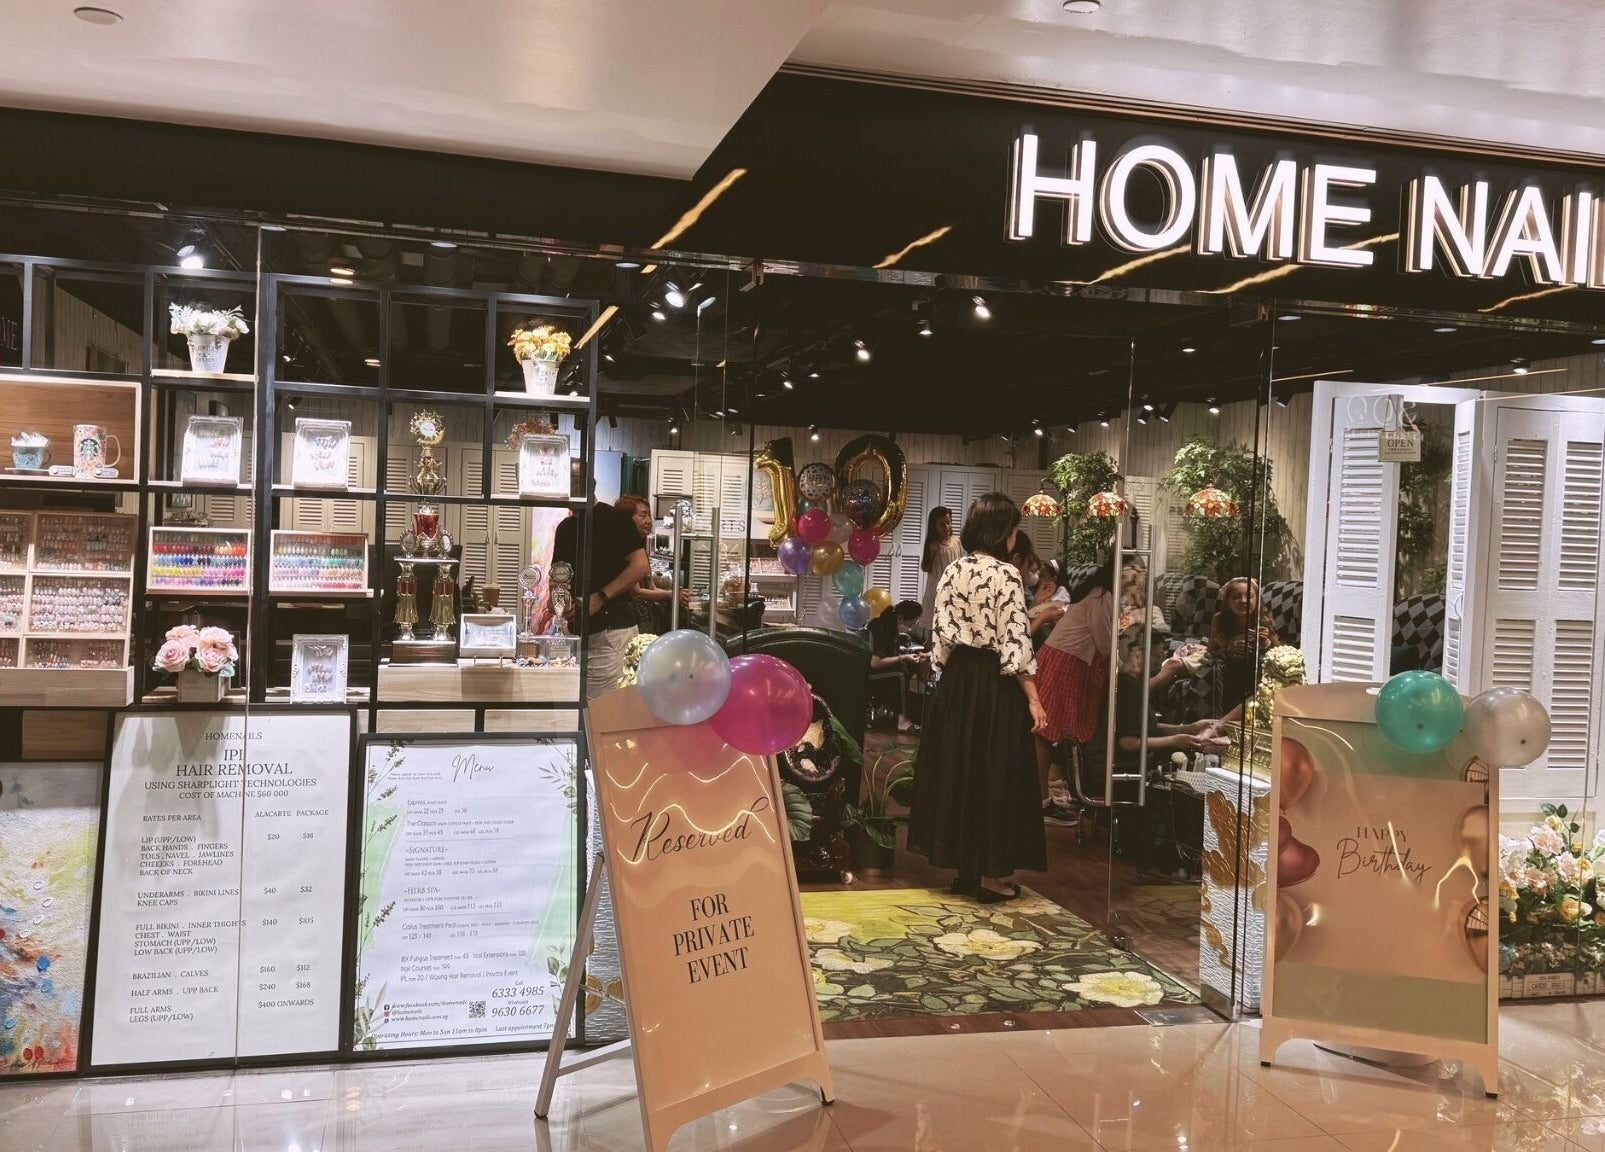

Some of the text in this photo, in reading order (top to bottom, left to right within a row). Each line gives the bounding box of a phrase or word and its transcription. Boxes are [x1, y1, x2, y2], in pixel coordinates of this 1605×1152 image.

[1008, 134, 1605, 288] HOME NAI
[1387, 439, 1414, 448] OPEN
[205, 732, 262, 740] HOMENILS
[176, 762, 292, 776] HAIR REMOVAL
[452, 754, 494, 783] Menu
[144, 778, 317, 790] USING SHARPLIGHT ECHNOLOGIES
[631, 797, 769, 861] Reserved
[154, 836, 196, 844] (UPP/LOW)
[1337, 838, 1432, 886] Birthday
[137, 891, 184, 899] UNDERARMS
[263, 887, 276, 895] $40
[690, 893, 728, 921] FOR
[673, 916, 755, 956] PRIVATE
[173, 937, 216, 946] (UPP/LOW)
[175, 945, 217, 954] (UPP/LOW)
[687, 947, 748, 984] EVENT
[132, 970, 208, 980] BRAZILIAN CALVES
[259, 983, 275, 991] $240
[492, 985, 545, 999] 6333 4985
[131, 989, 151, 997] HALF
[258, 998, 314, 1008] $400 ONWARDS
[150, 1005, 172, 1013] ARMS
[491, 1004, 545, 1017] 9630 6677
[129, 1013, 193, 1023] LEGS (UPP/LOW)
[508, 1024, 543, 1033] appointment
